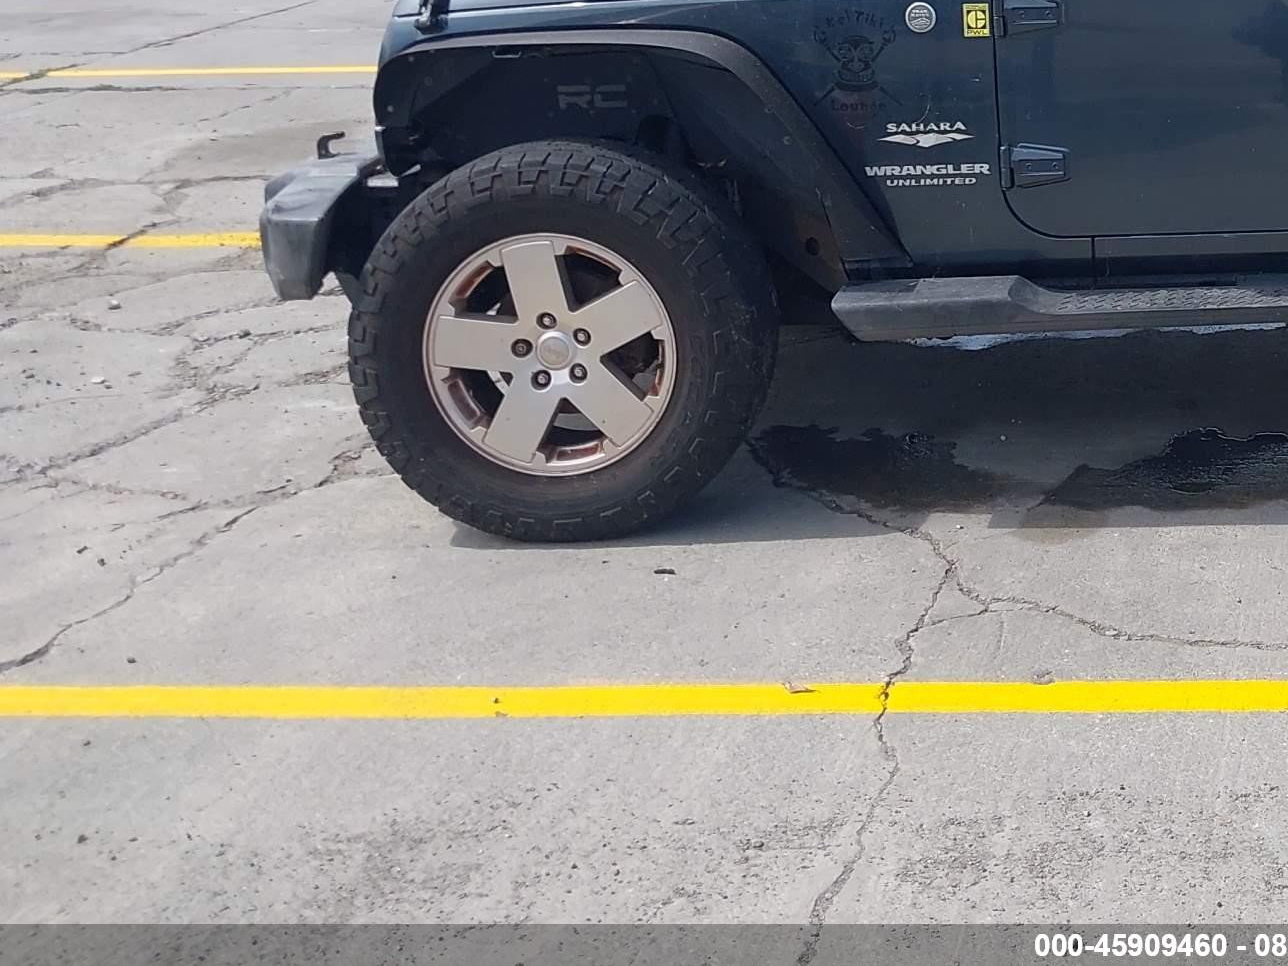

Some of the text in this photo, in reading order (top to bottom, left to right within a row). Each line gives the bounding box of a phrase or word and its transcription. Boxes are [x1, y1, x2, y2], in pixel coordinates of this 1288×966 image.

[556, 84, 628, 109] RC
[885, 121, 967, 133] SAHARA
[864, 163, 991, 176] WRANGLER
[886, 177, 977, 187] UNLIMITED
